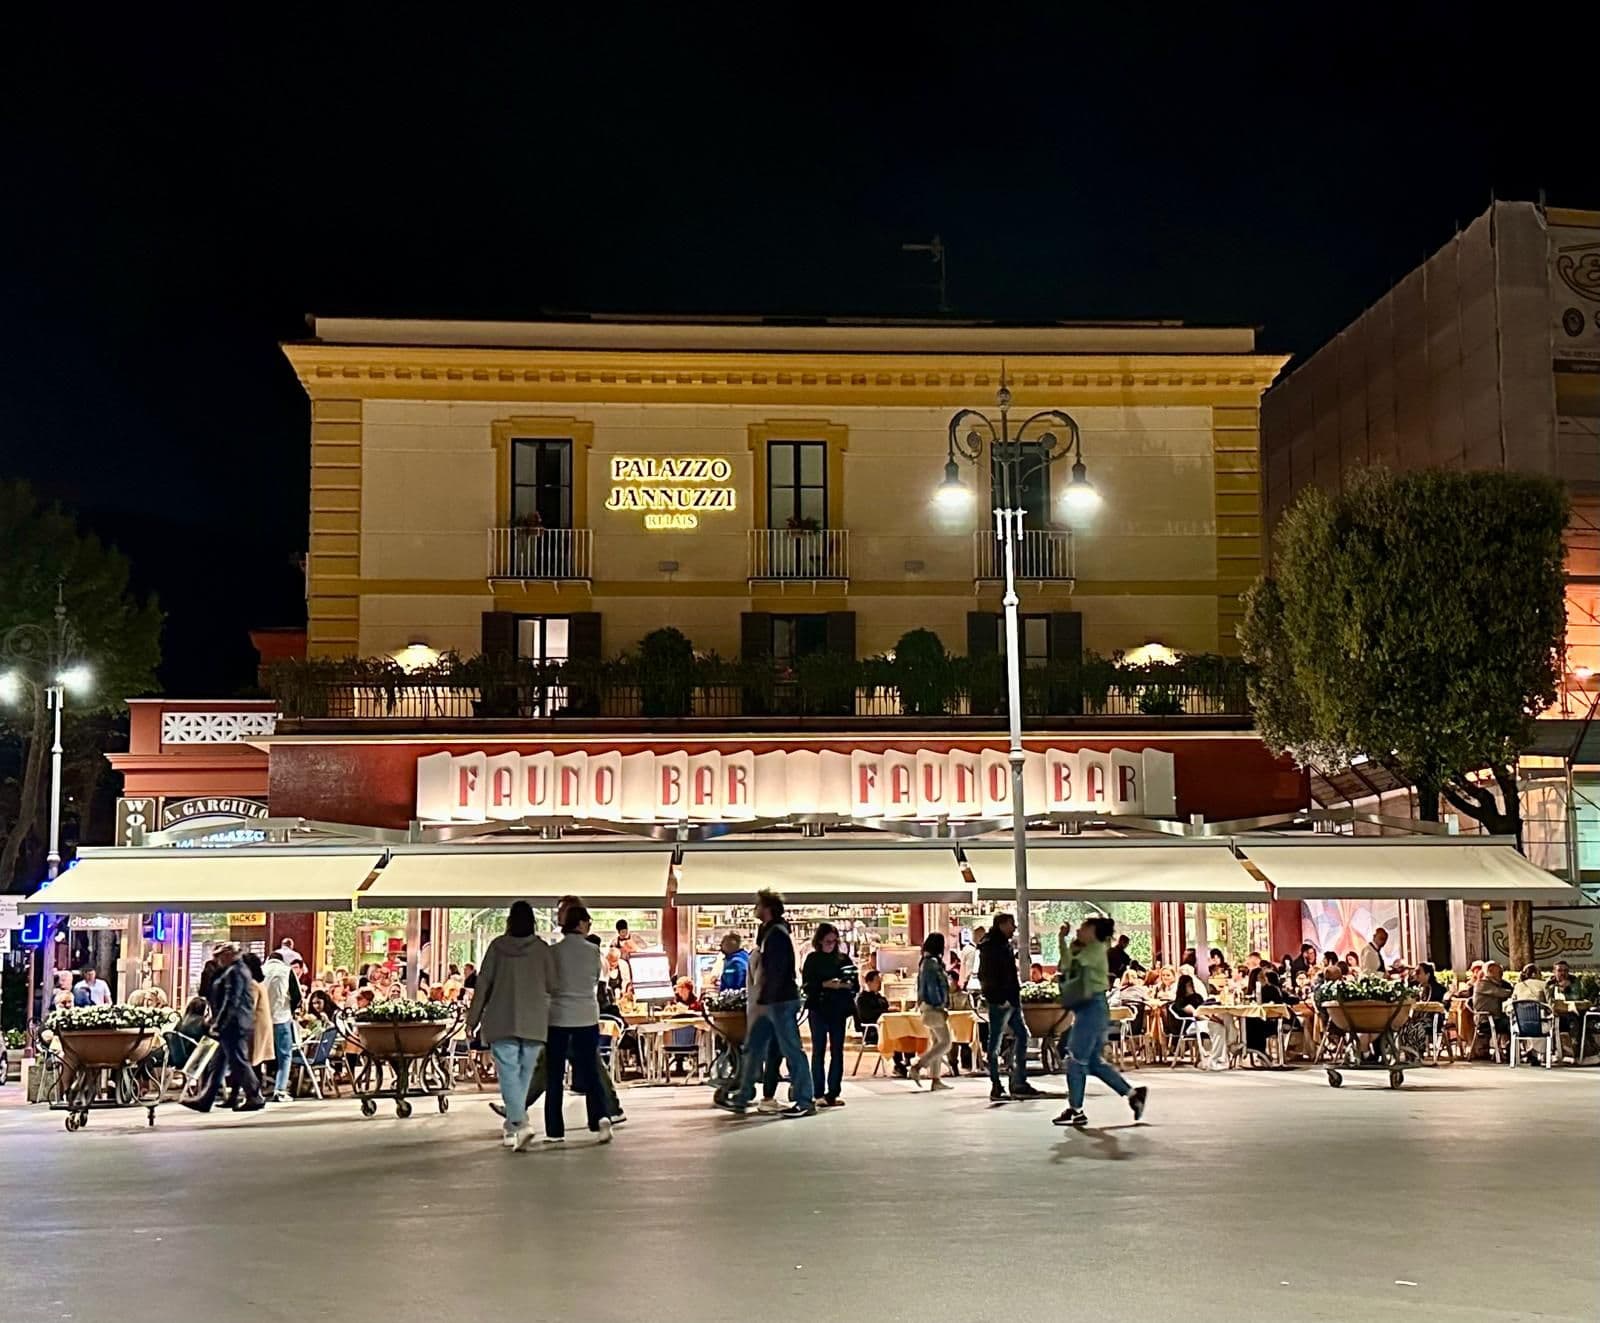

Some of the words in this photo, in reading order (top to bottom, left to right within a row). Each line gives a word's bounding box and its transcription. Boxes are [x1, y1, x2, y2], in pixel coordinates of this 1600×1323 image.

[613, 459, 730, 479] PALAZZO
[607, 488, 735, 508] JANNUZZI
[646, 515, 697, 526] RELAIS
[459, 765, 613, 806] FAUNO
[661, 764, 747, 806] BAR
[859, 762, 1007, 804] FAUNO
[1053, 761, 1137, 802] BAR
[164, 810, 181, 824] A.
[182, 799, 270, 819] GARGIULO
